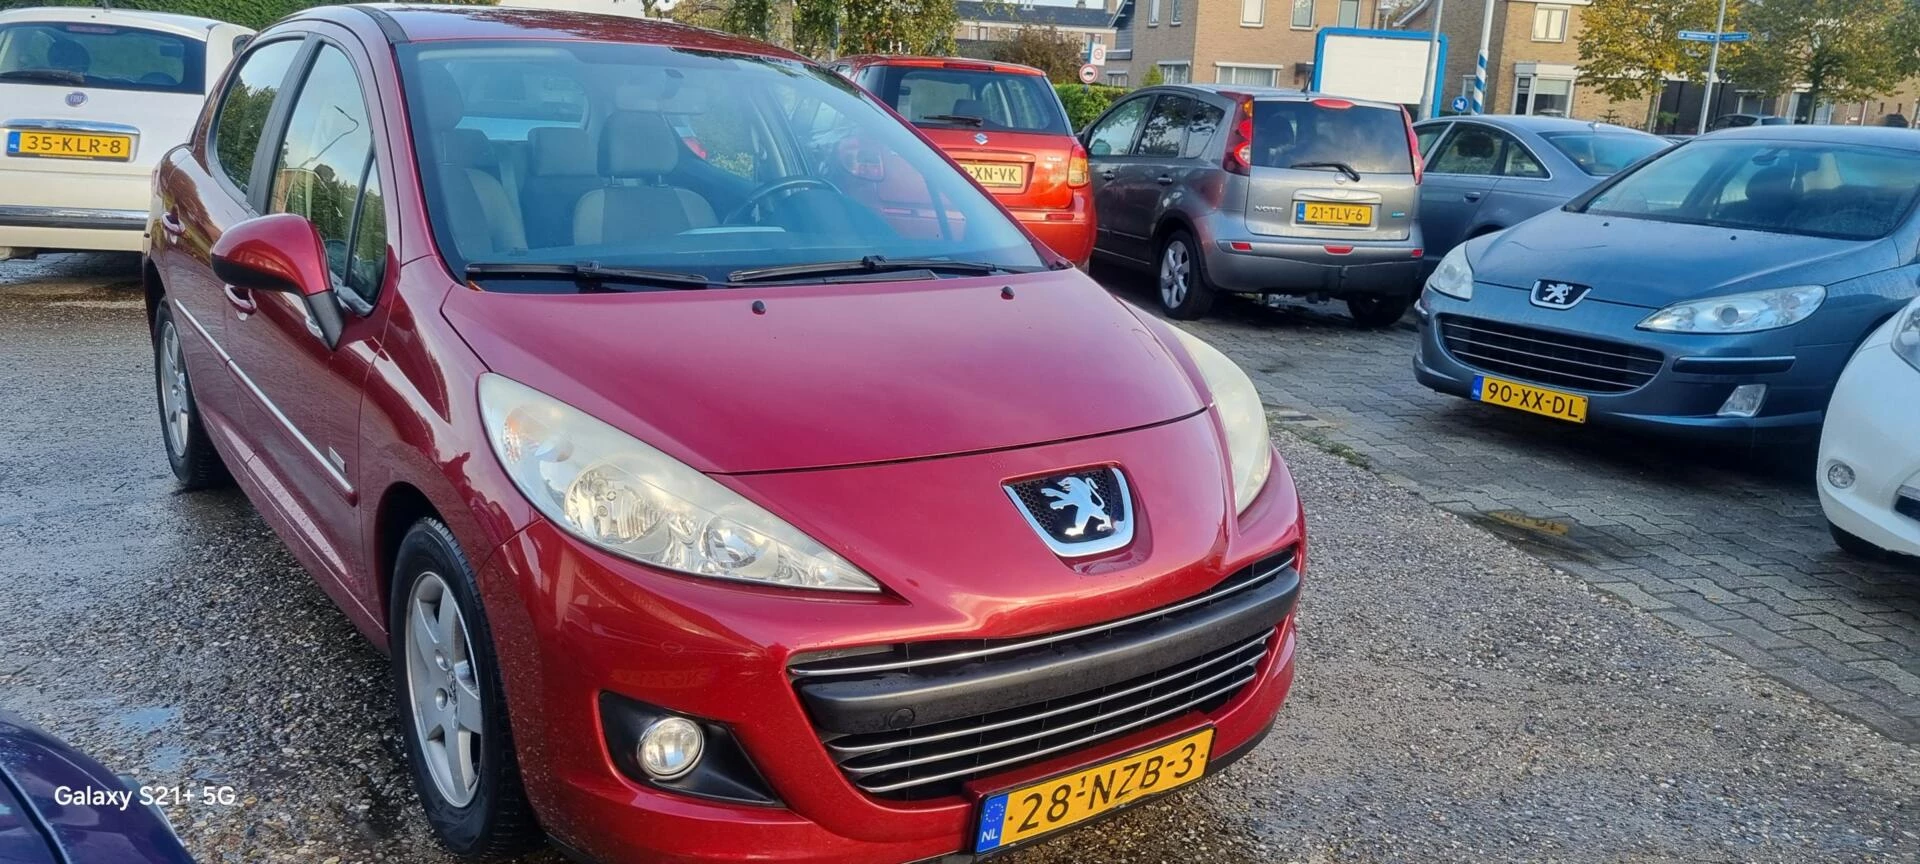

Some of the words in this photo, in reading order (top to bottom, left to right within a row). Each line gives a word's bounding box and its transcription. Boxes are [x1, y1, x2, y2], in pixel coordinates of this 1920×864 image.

[27, 135, 121, 154] 35-KLR-8
[1311, 206, 1364, 222] 21-TLV-6
[1488, 382, 1578, 418] 90-XX-DL
[981, 827, 999, 844] NL
[1016, 742, 1197, 834] 28-NZB-3
